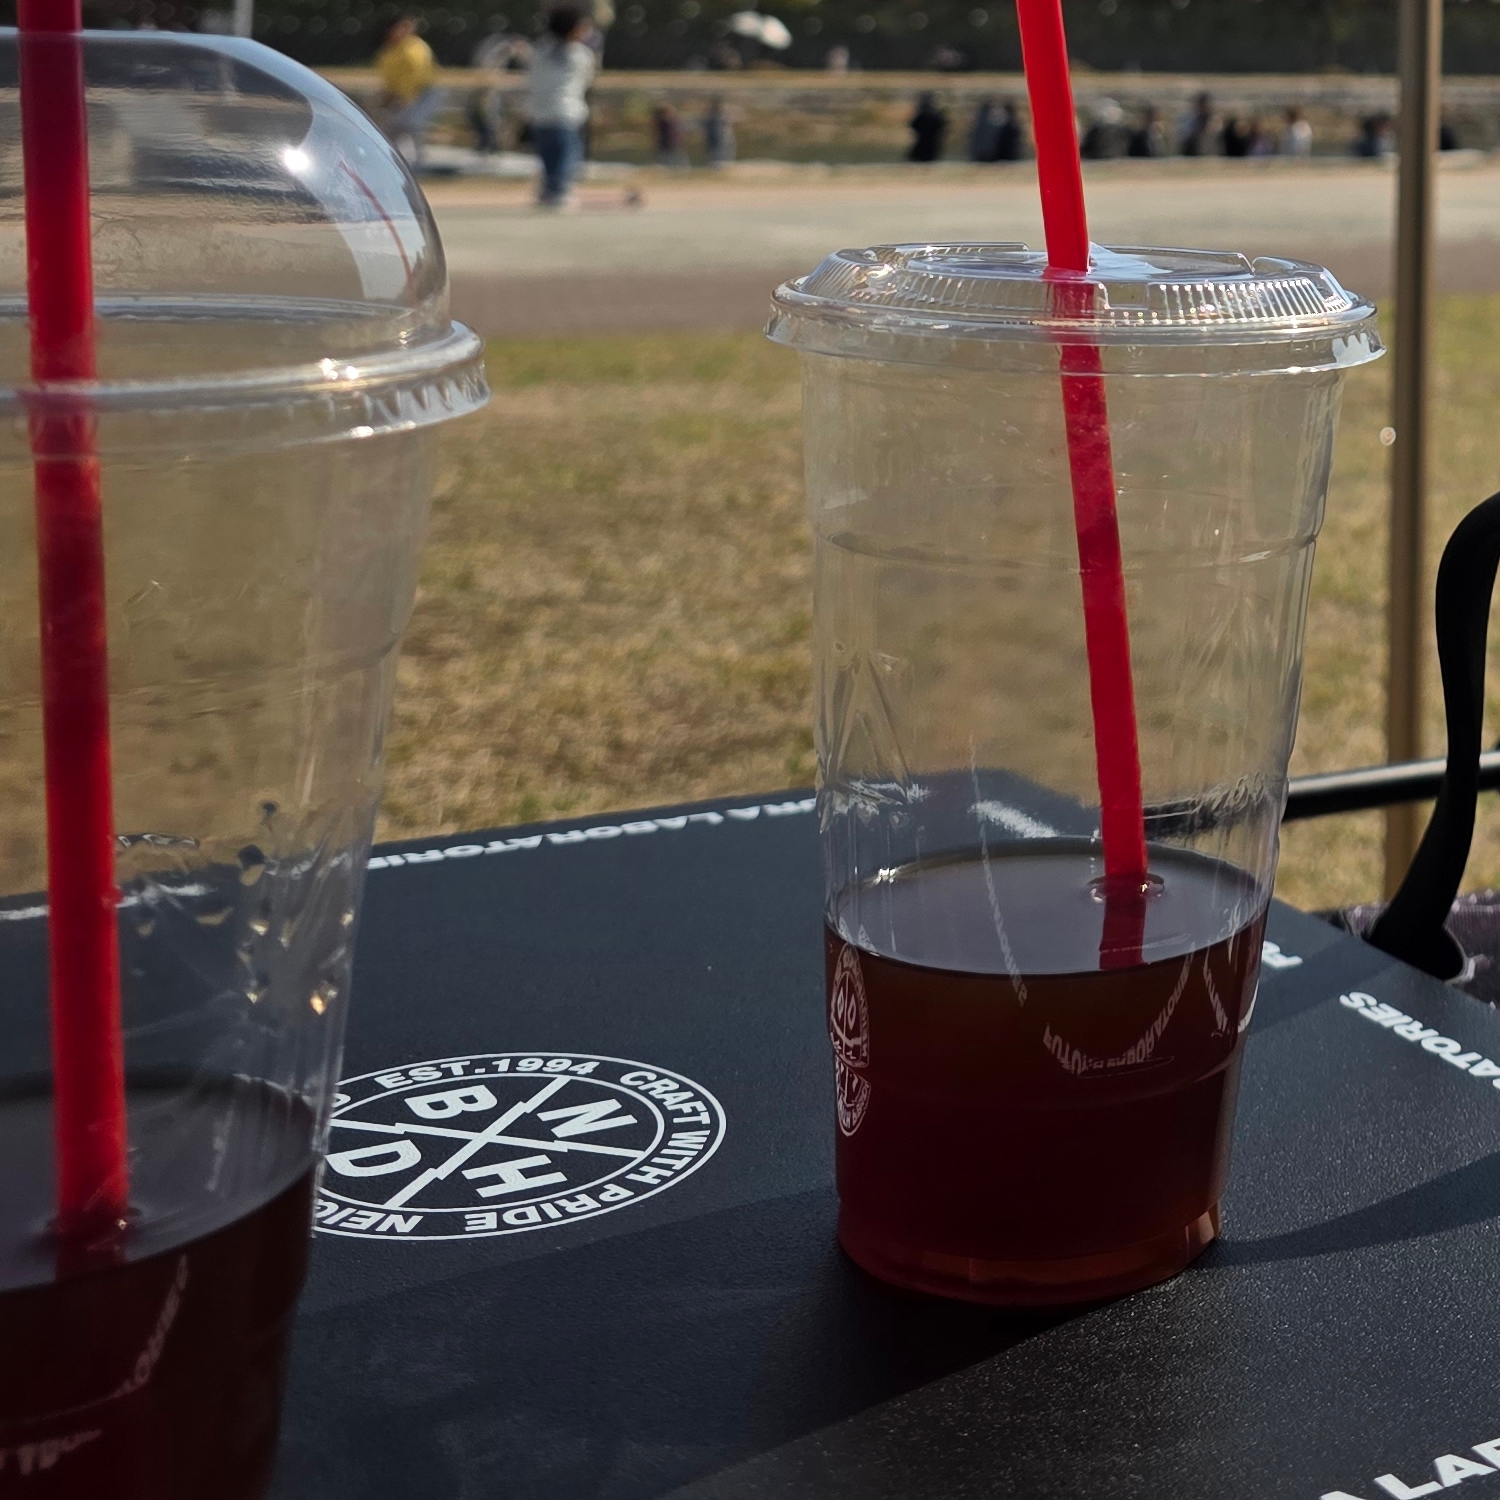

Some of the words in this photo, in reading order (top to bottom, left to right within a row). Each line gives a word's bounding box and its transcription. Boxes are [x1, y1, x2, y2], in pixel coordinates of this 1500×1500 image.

[367, 809, 724, 869] LABORATORIE
[620, 1071, 711, 1124] CRAFT
[626, 1130, 711, 1184] WITH
[464, 1183, 635, 1232] PRIDE
